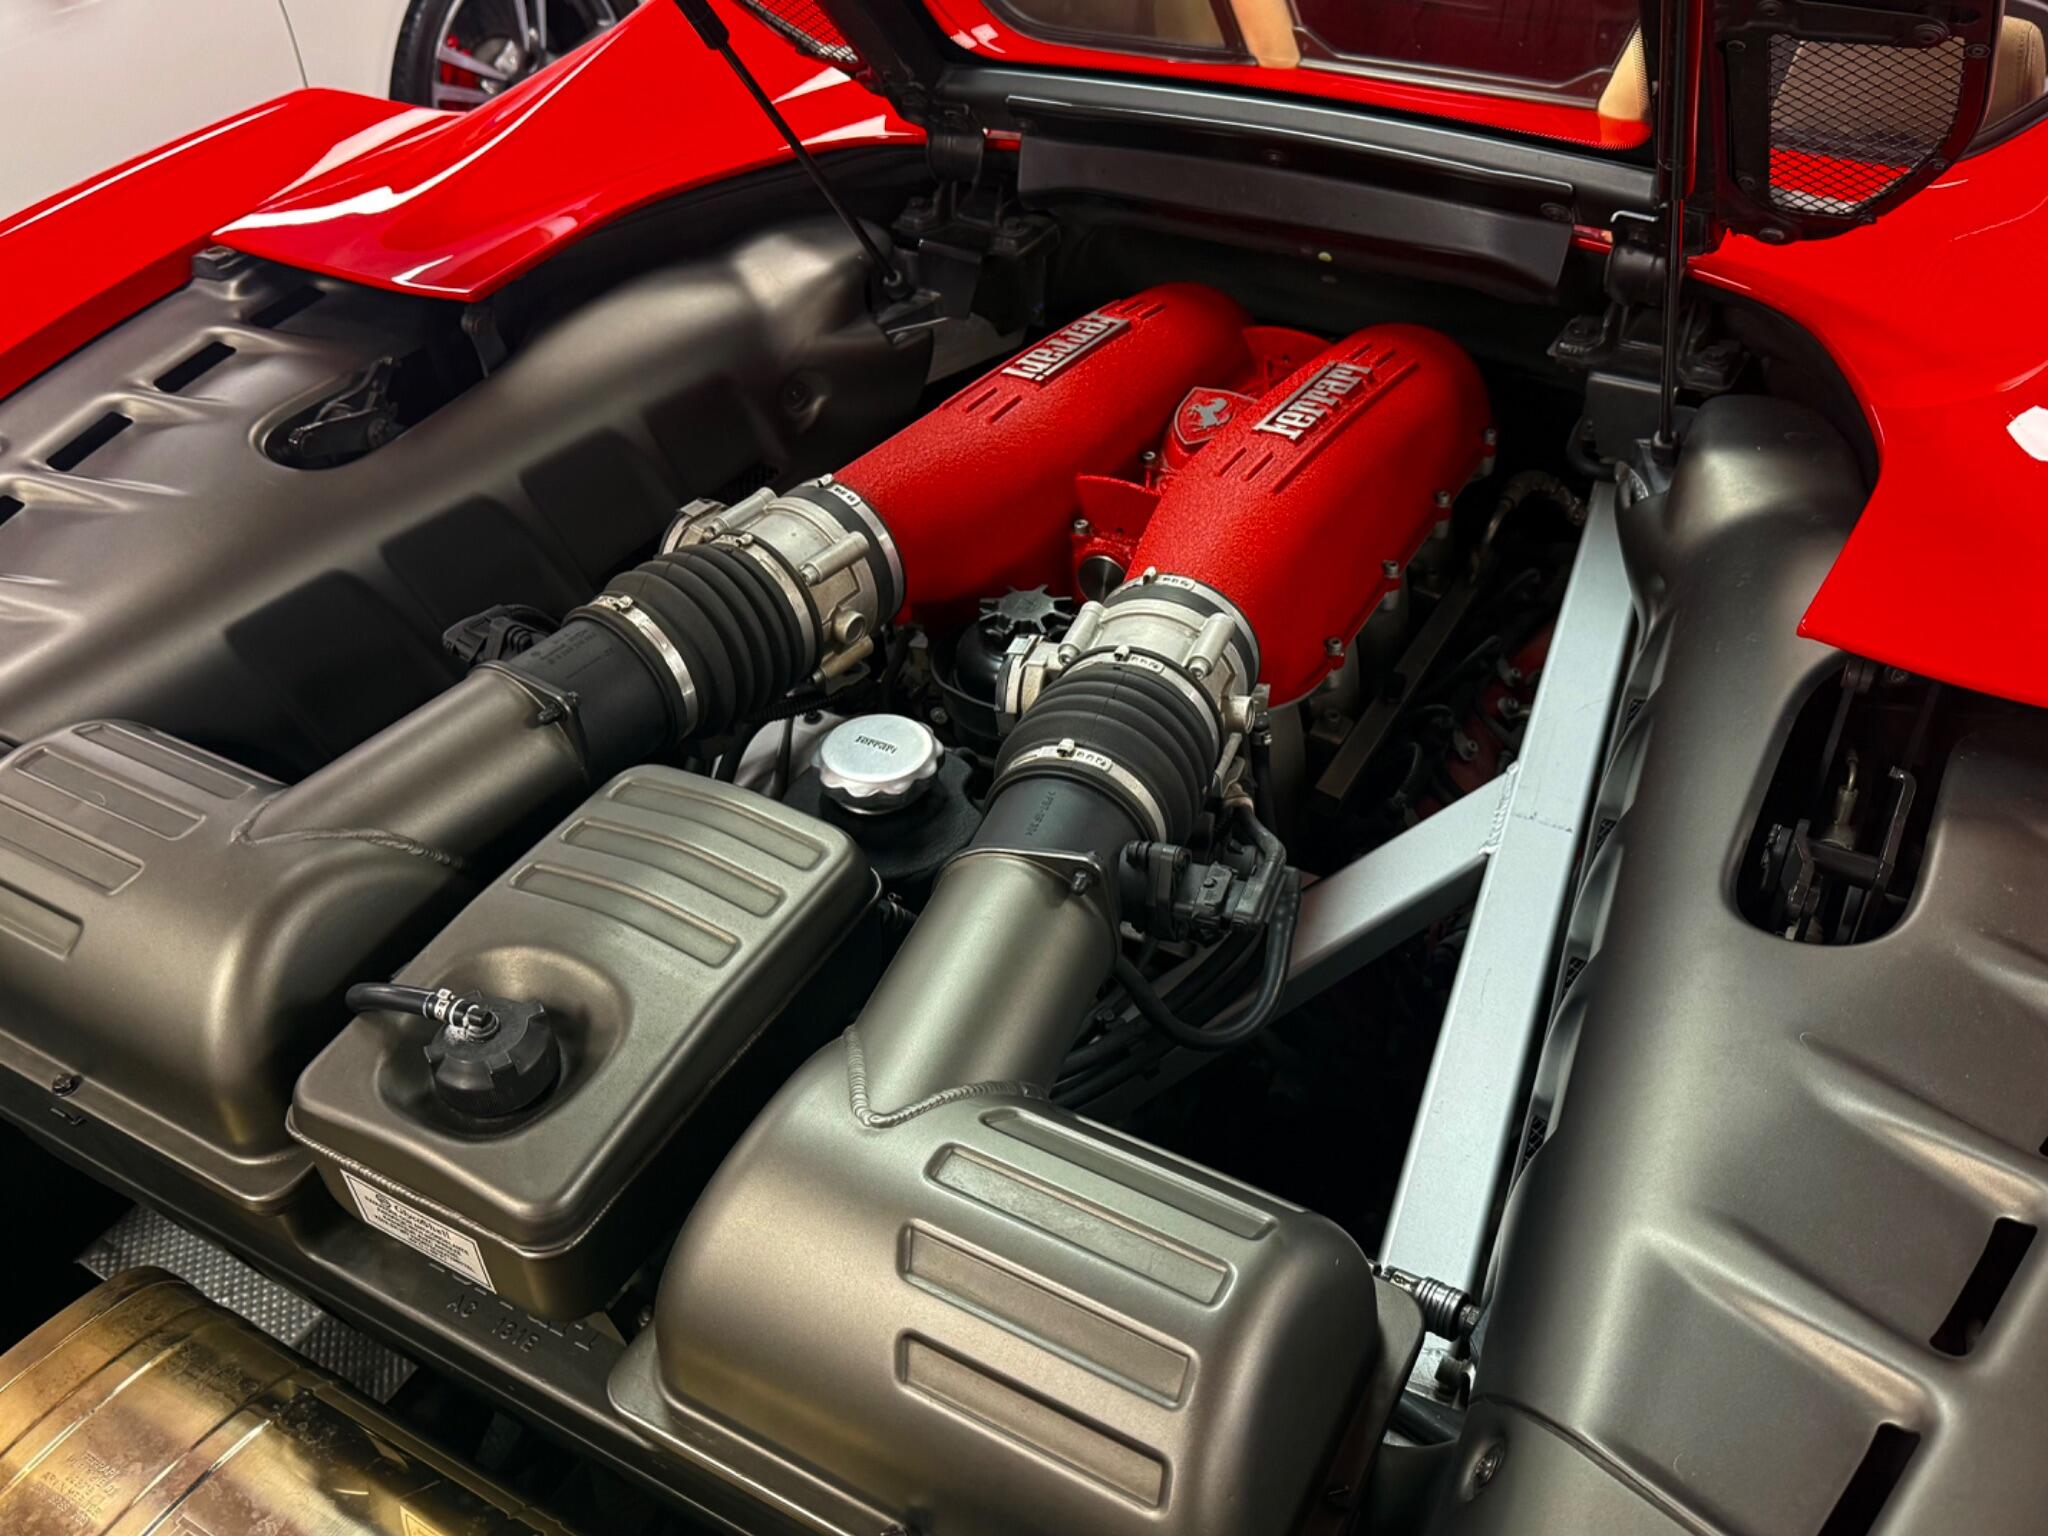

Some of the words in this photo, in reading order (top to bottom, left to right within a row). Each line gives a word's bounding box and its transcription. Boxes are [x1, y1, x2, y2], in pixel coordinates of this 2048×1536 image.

[1001, 313, 1130, 382] Ferrari
[1252, 360, 1373, 441] Ferrari
[853, 735, 898, 755] Ferrari
